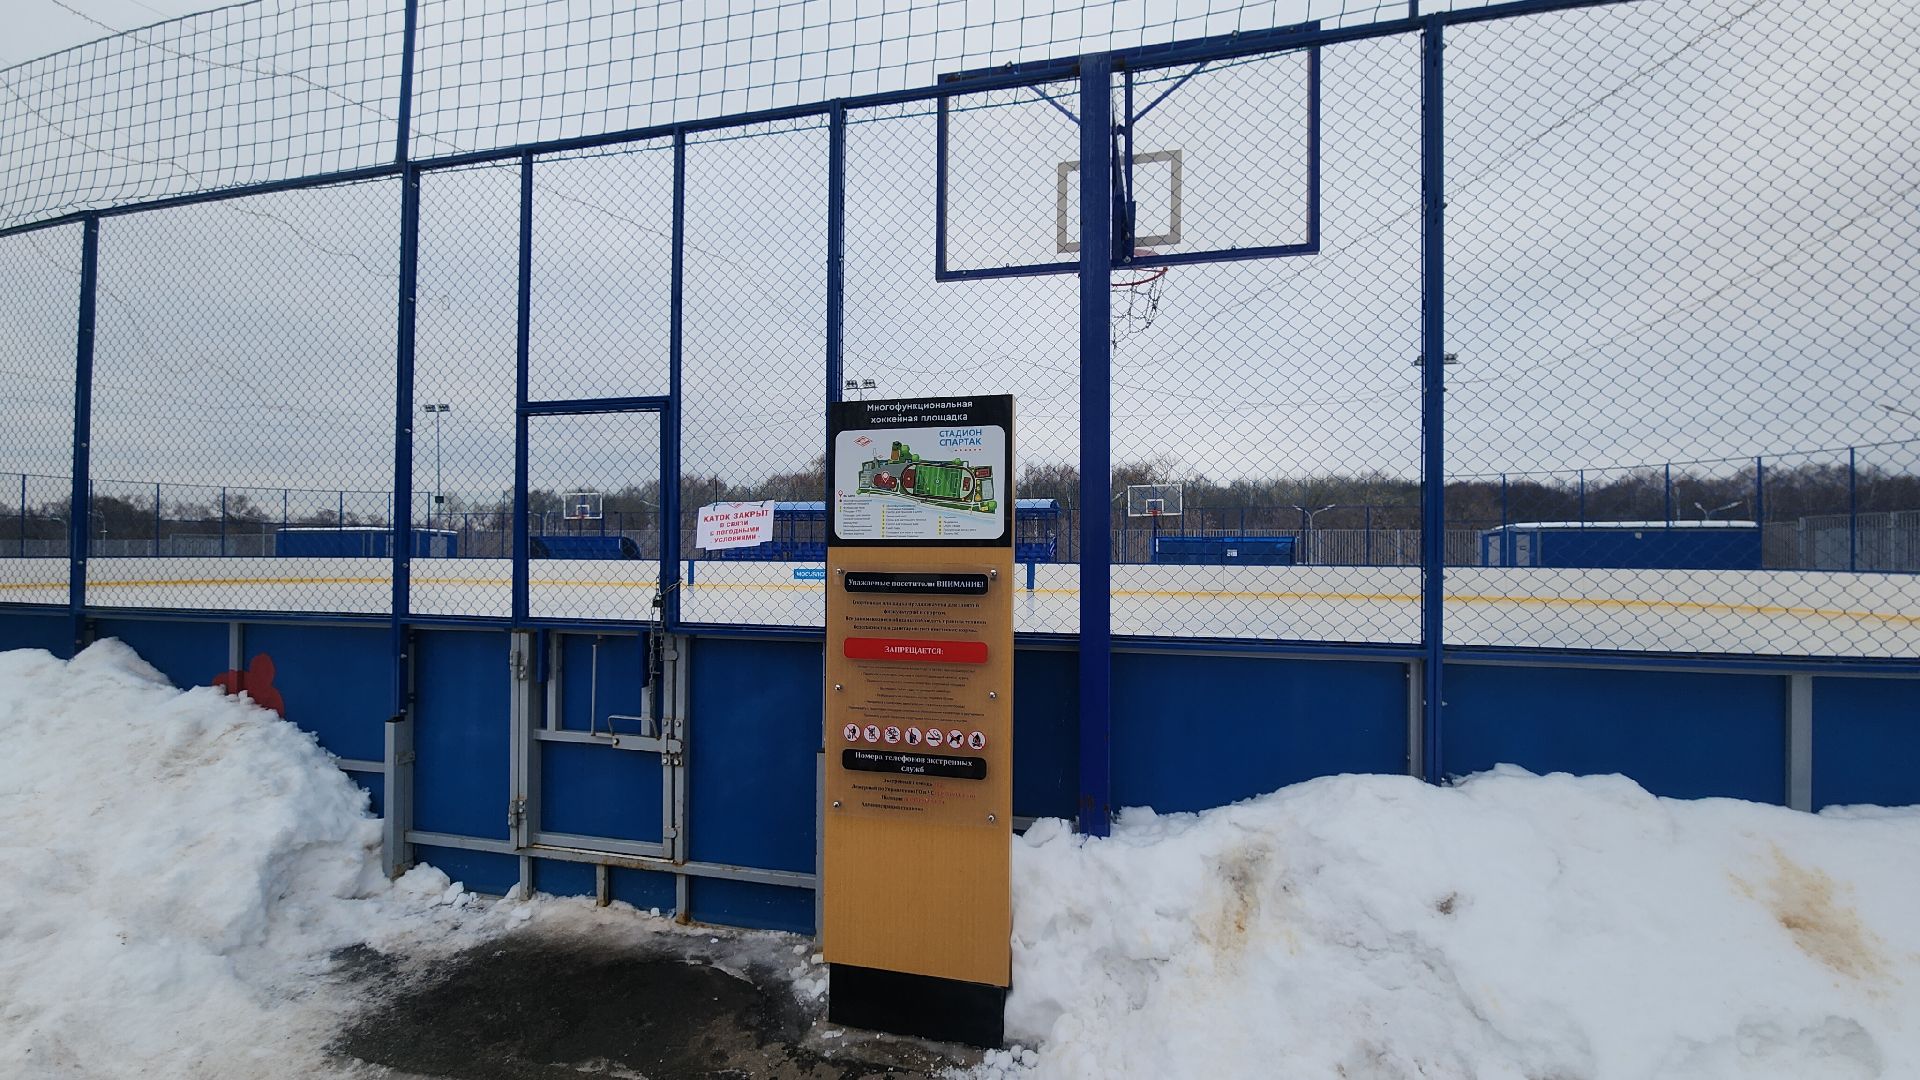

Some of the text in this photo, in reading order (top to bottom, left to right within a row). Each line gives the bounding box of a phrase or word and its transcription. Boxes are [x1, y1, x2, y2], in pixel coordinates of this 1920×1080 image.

[866, 401, 973, 413] Многофункциональная
[870, 412, 968, 424] хоккейная площадка
[939, 429, 982, 438] СТАДИОН
[939, 437, 982, 446] СПАРТАК
[703, 509, 770, 523] КАТОК ЗАКРЫТ
[726, 520, 749, 528] СВЯЗИ
[716, 526, 760, 536] ПОГОДНЫМИ
[714, 534, 757, 543] УСЛОВИЯМИ
[848, 578, 984, 588] Уважаемые посетители ВНИМАНИЕ!
[884, 645, 944, 655] ЗАПРЕЩАЕТСЯ:
[855, 751, 973, 767] Номера телефонов экстренных
[900, 765, 925, 773] служб
